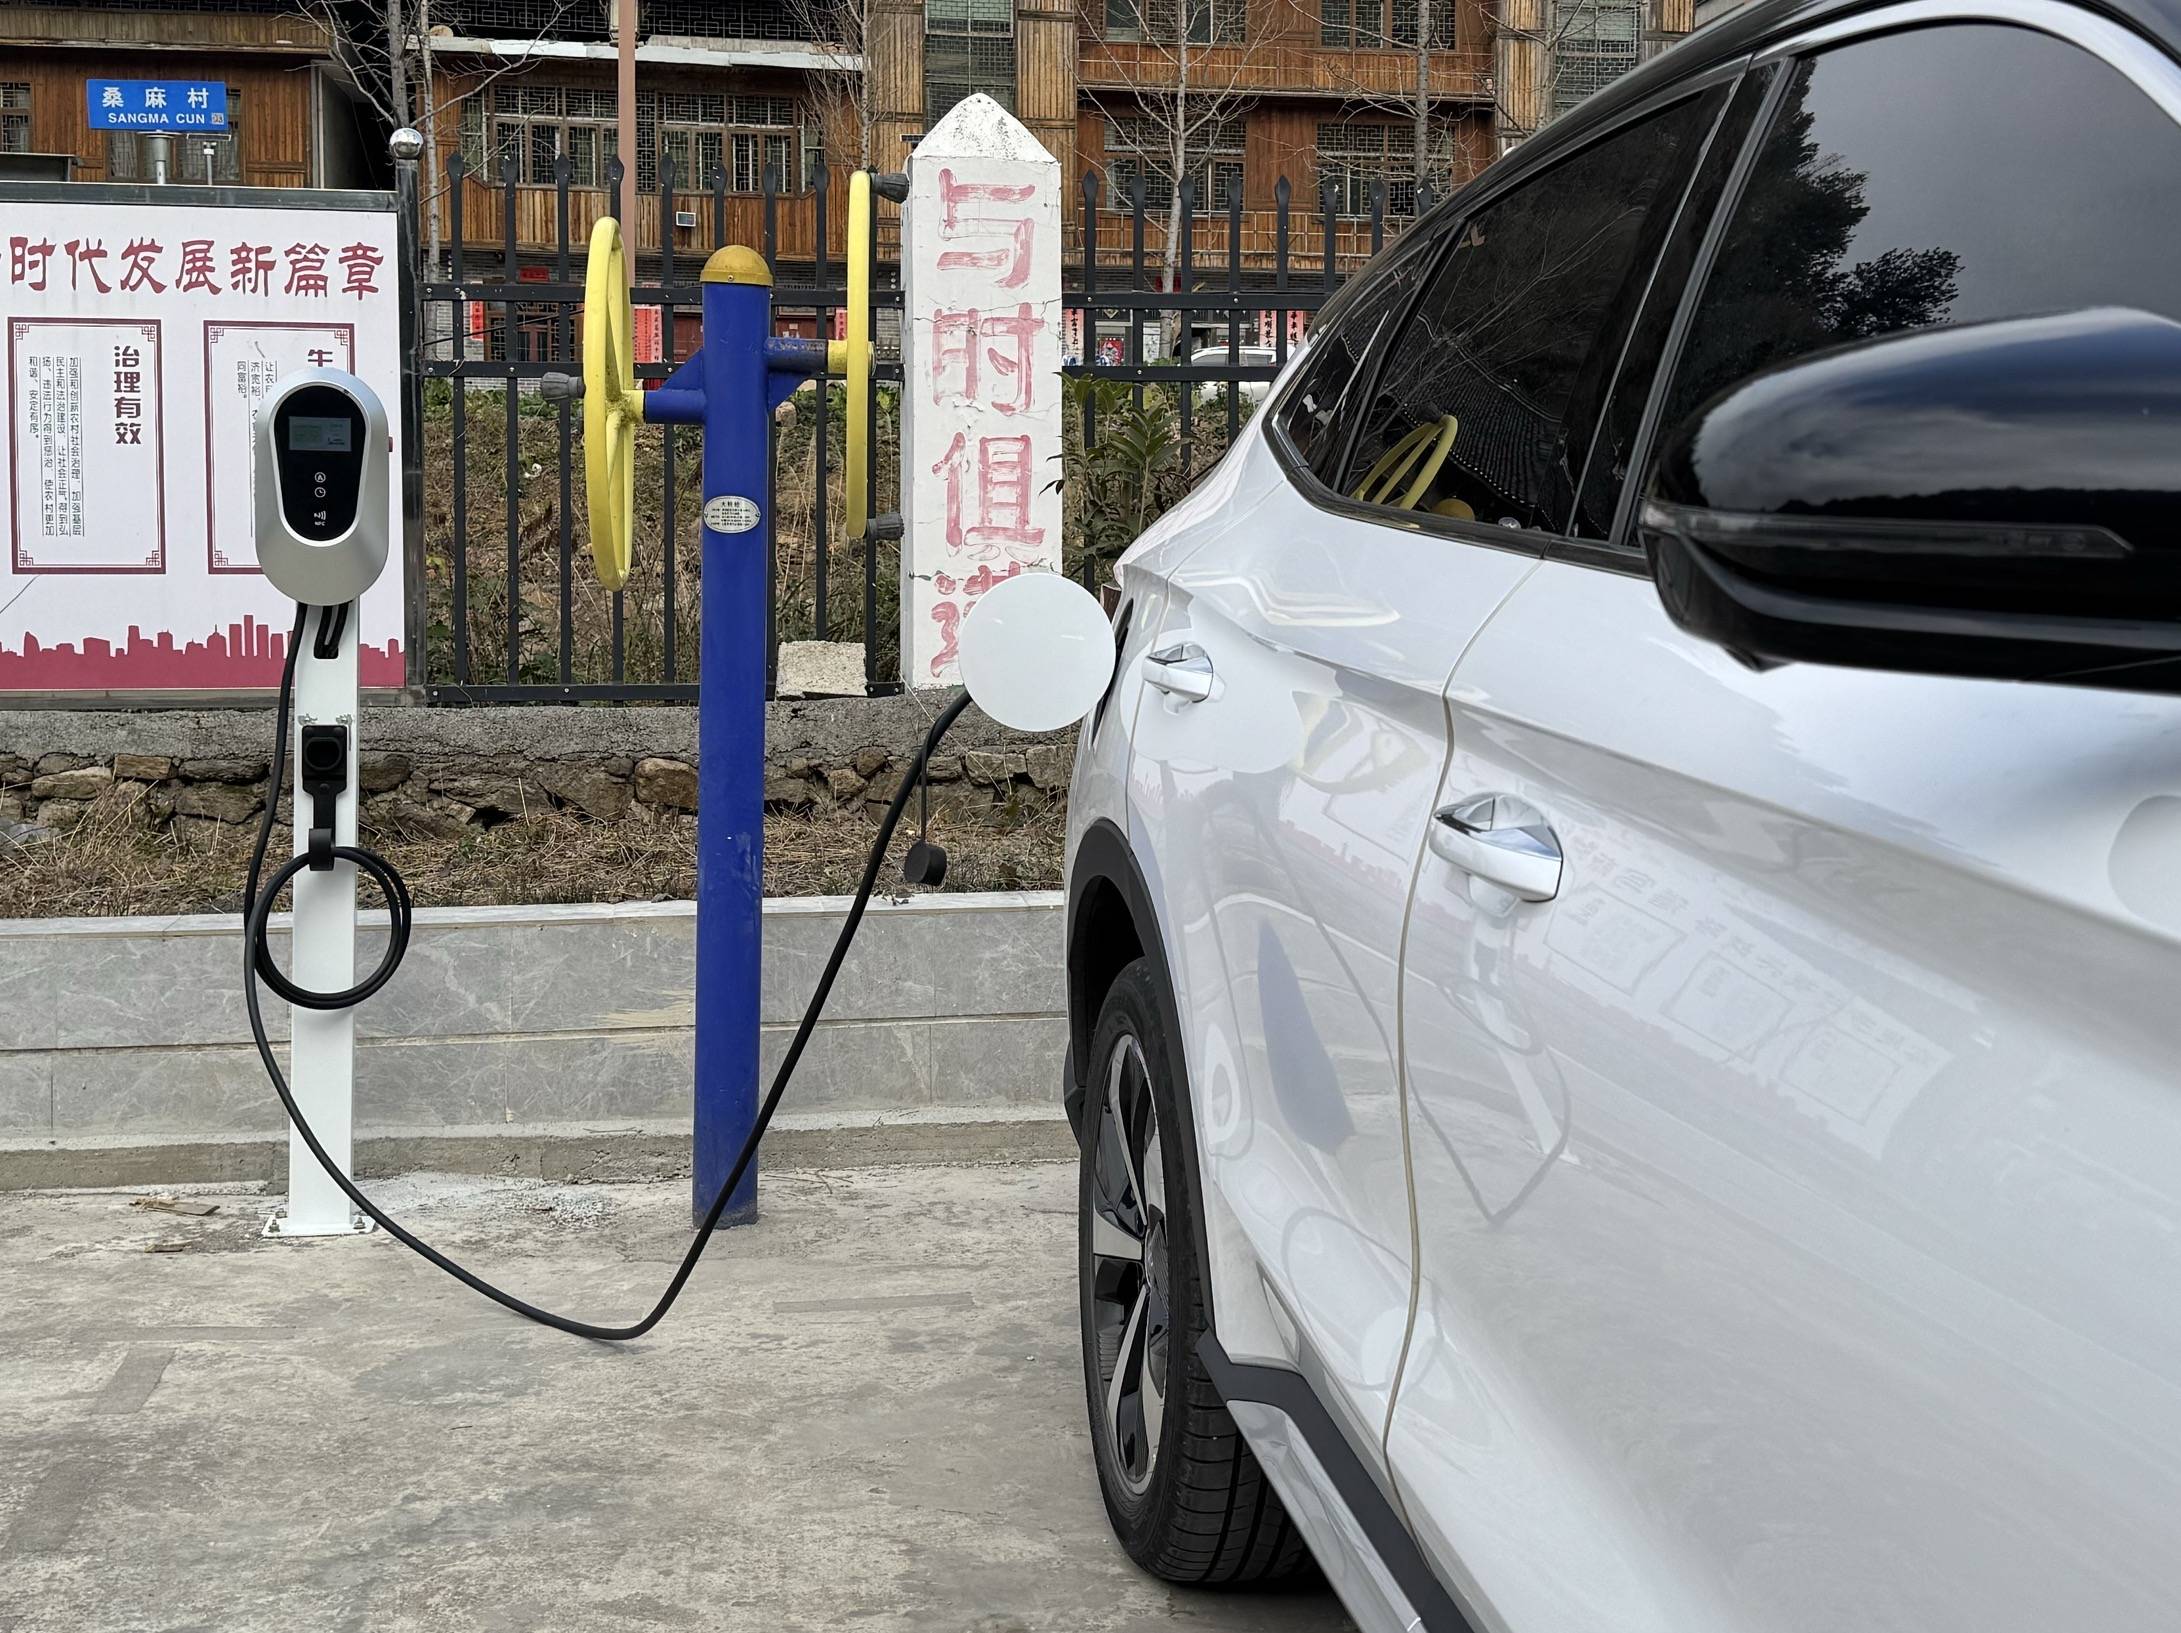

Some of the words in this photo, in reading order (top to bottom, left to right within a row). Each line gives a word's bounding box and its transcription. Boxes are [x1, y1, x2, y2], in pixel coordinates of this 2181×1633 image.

[102, 87, 209, 109] 桑麻村
[108, 112, 169, 124] SANGMA
[176, 113, 205, 124] CUN
[0, 235, 385, 301] 时代发展新篇章
[114, 345, 142, 445] 治理有效
